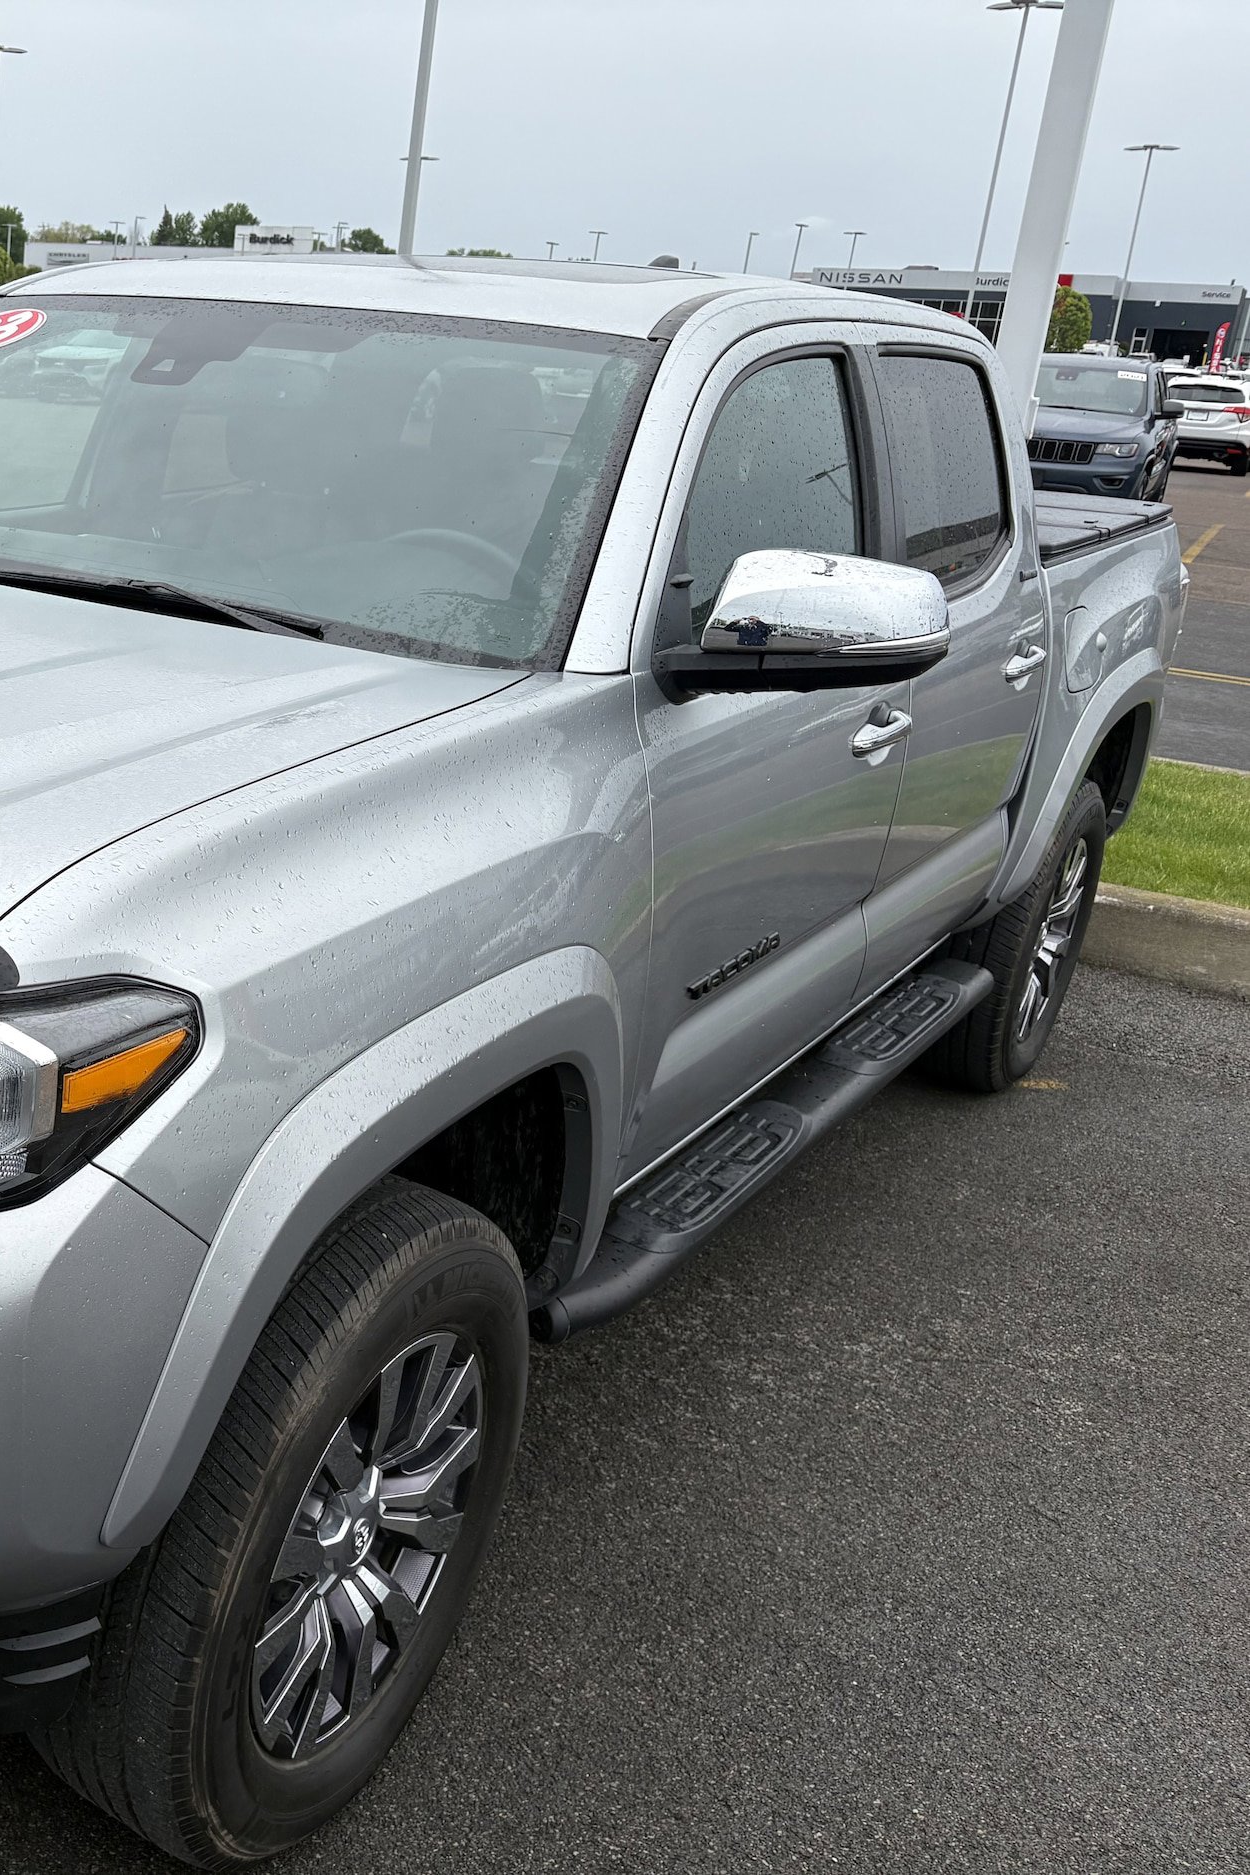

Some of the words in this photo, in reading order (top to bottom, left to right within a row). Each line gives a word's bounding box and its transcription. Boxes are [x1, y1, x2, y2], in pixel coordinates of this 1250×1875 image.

[249, 233, 295, 246] Burdick
[819, 271, 903, 284] NISSAN
[975, 277, 1010, 286] urdic
[1201, 291, 1232, 299] Service
[686, 931, 781, 1000] TACOMA
